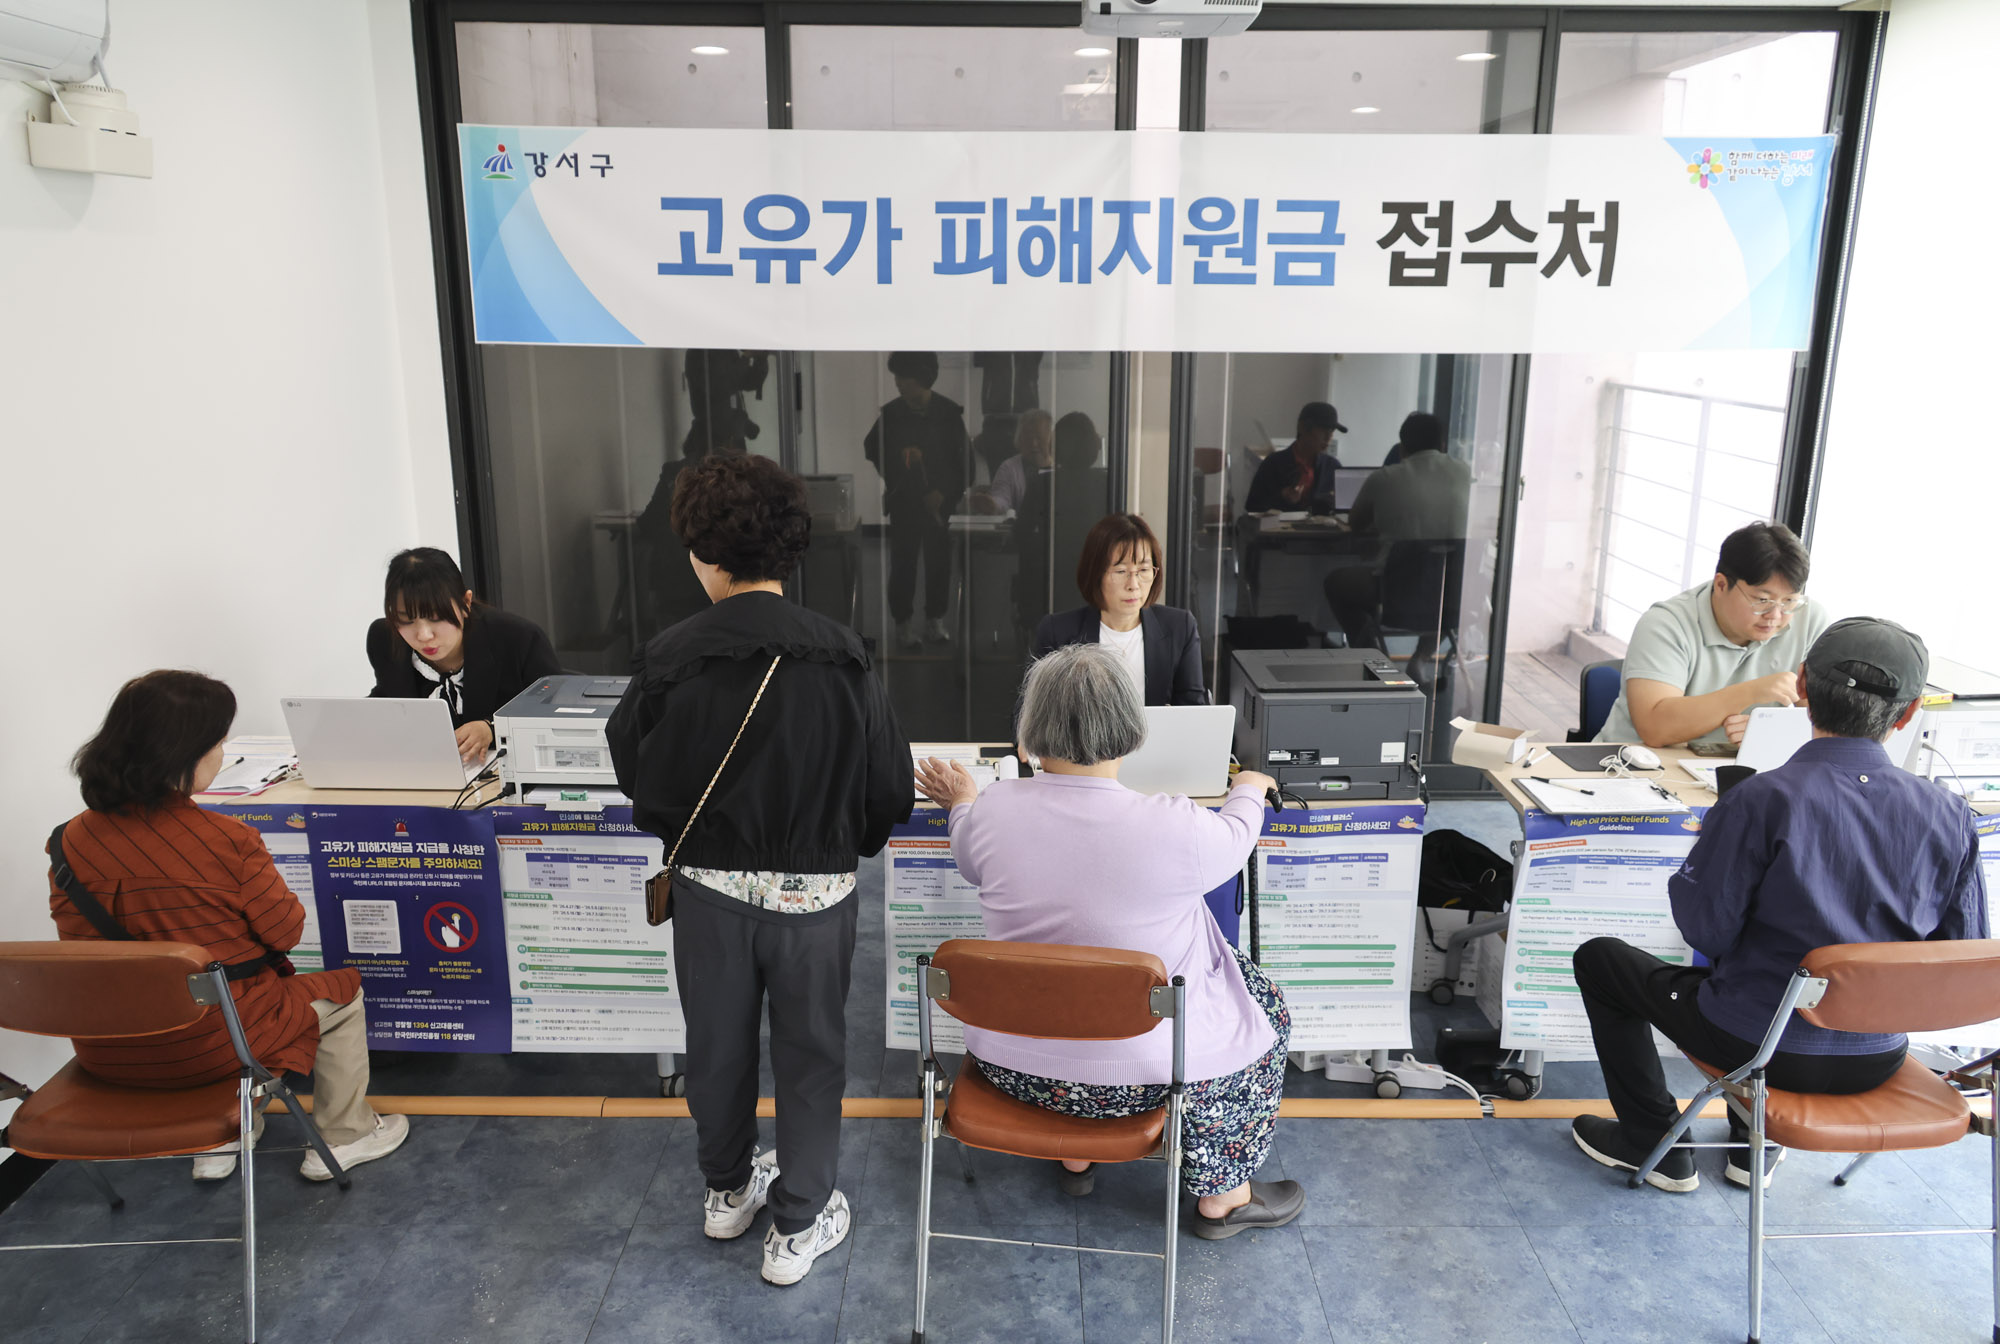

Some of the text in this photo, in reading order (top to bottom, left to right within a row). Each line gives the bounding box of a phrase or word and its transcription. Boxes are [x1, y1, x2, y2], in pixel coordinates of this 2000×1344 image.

[524, 151, 615, 179] 강서구
[1728, 150, 1814, 166] 함께 더하는 미래
[1726, 164, 1813, 186] 같이 나누는 강서
[657, 193, 1621, 288] 고유가 피해지원금 접수처
[522, 823, 549, 831] 고유가
[551, 823, 596, 832] 피해지원금
[928, 818, 947, 826] High
[1269, 821, 1391, 833] 고유가 피해지원금 신청하세요!
[1570, 818, 1588, 827] High
[320, 841, 485, 856] 고유가 피해지원금 지급을 사칭한
[328, 856, 482, 870] 스미싱·스팸문자를 주의하세요!
[758, 1176, 766, 1194] N
[820, 1222, 828, 1240] N
